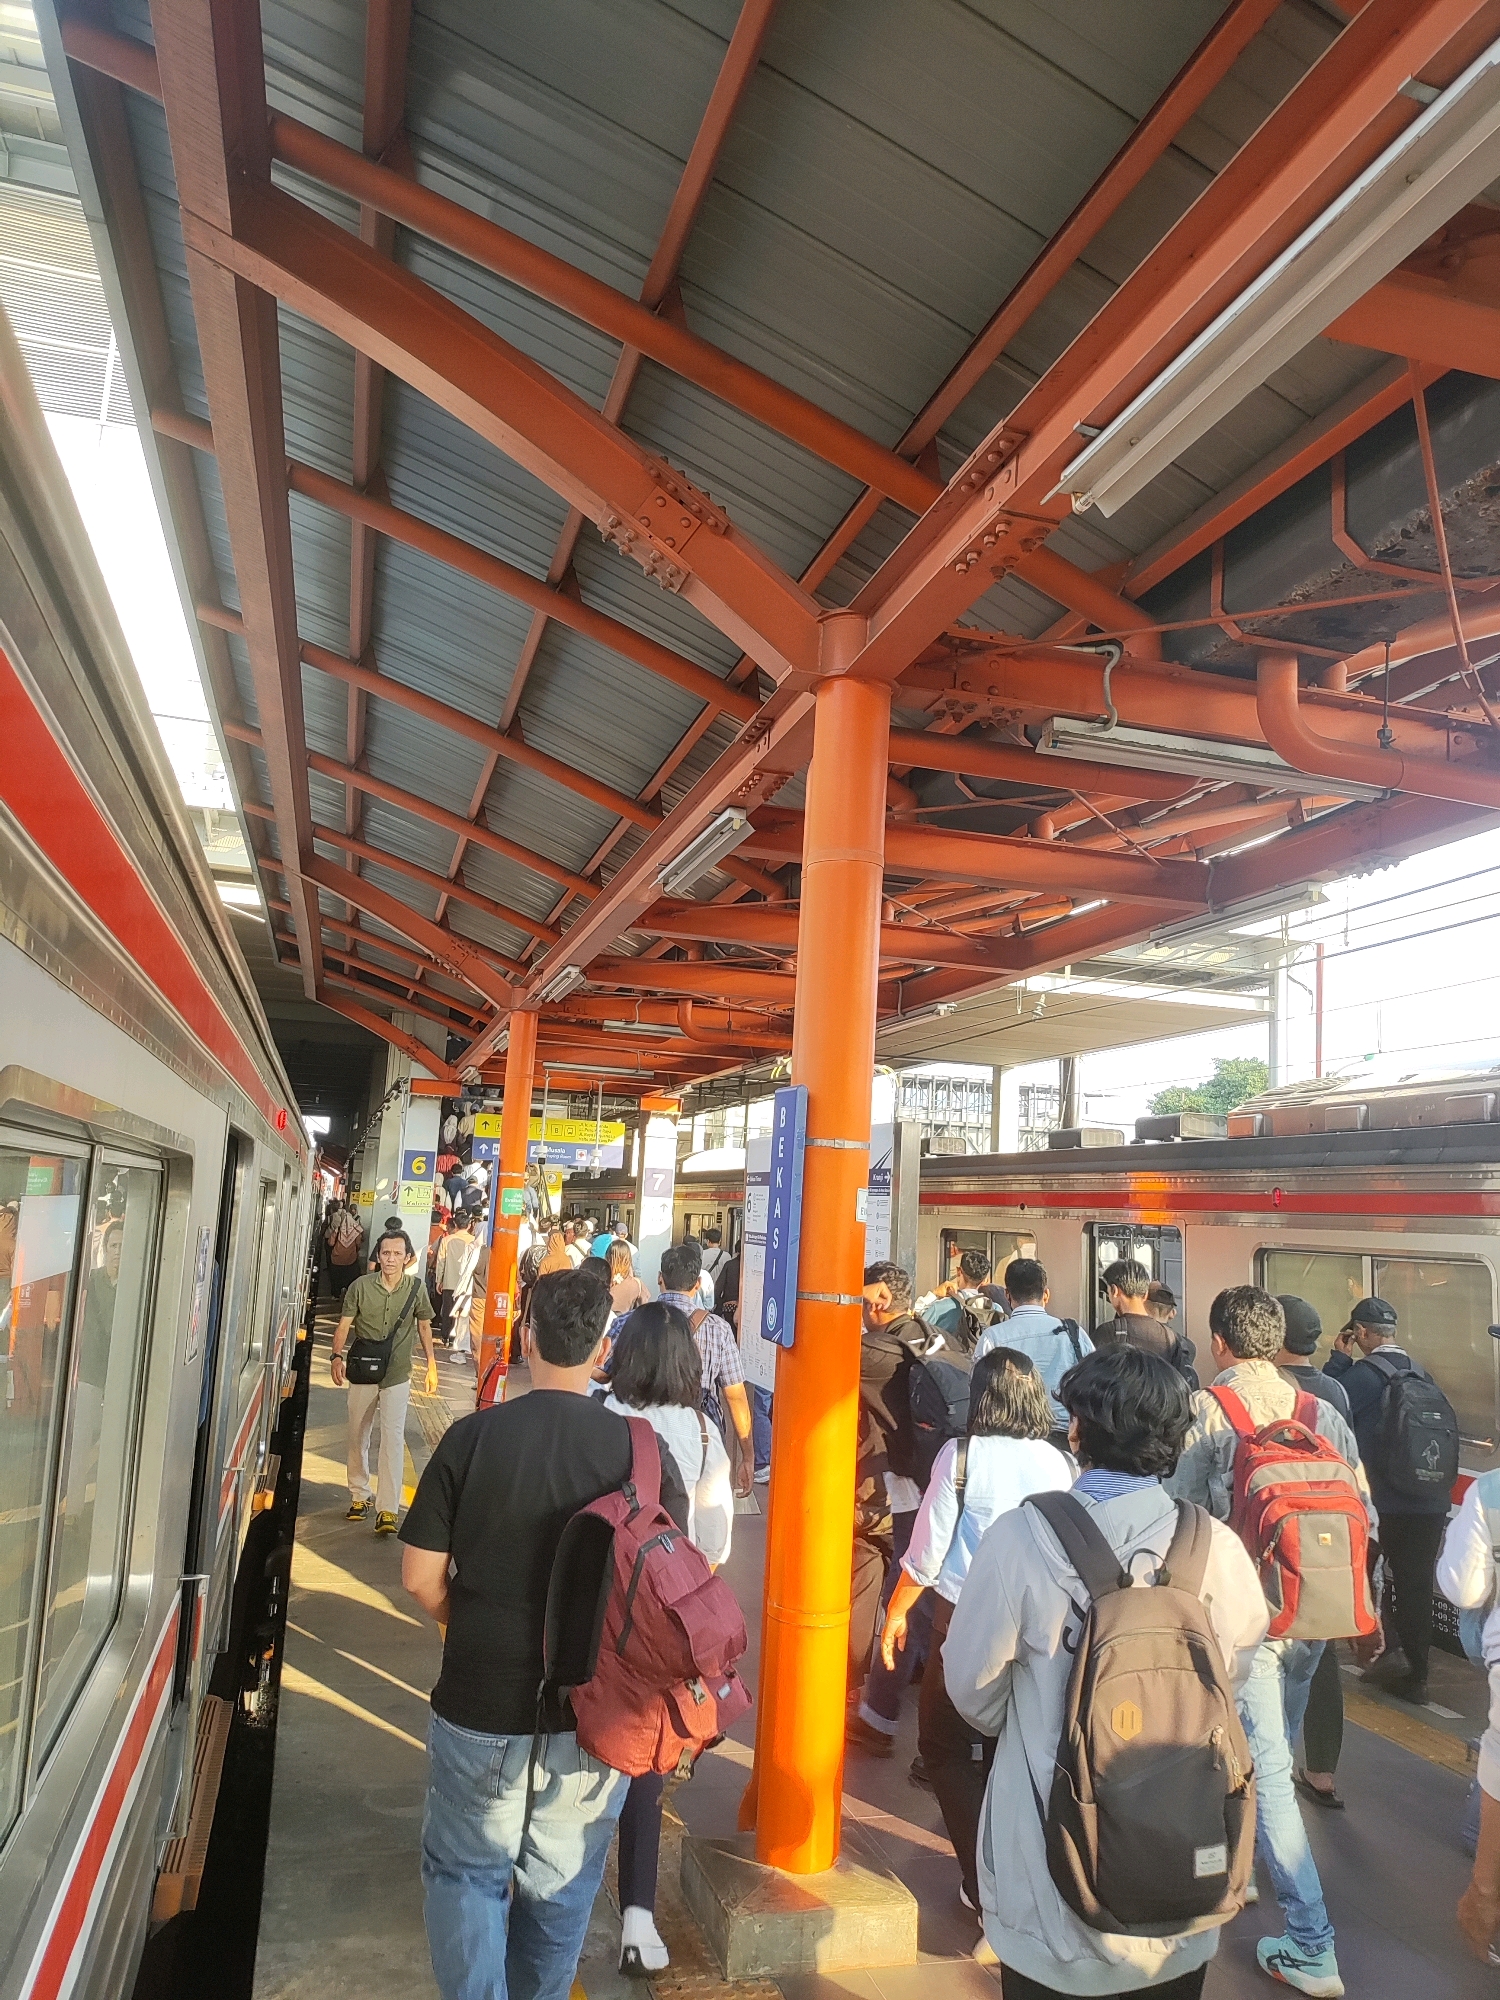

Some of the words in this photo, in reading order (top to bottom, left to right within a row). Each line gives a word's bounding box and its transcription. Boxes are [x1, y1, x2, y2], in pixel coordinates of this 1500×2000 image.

[411, 1156, 427, 1175] 6
[652, 1173, 666, 1191] 7
[772, 1105, 787, 1280] BEKASI
